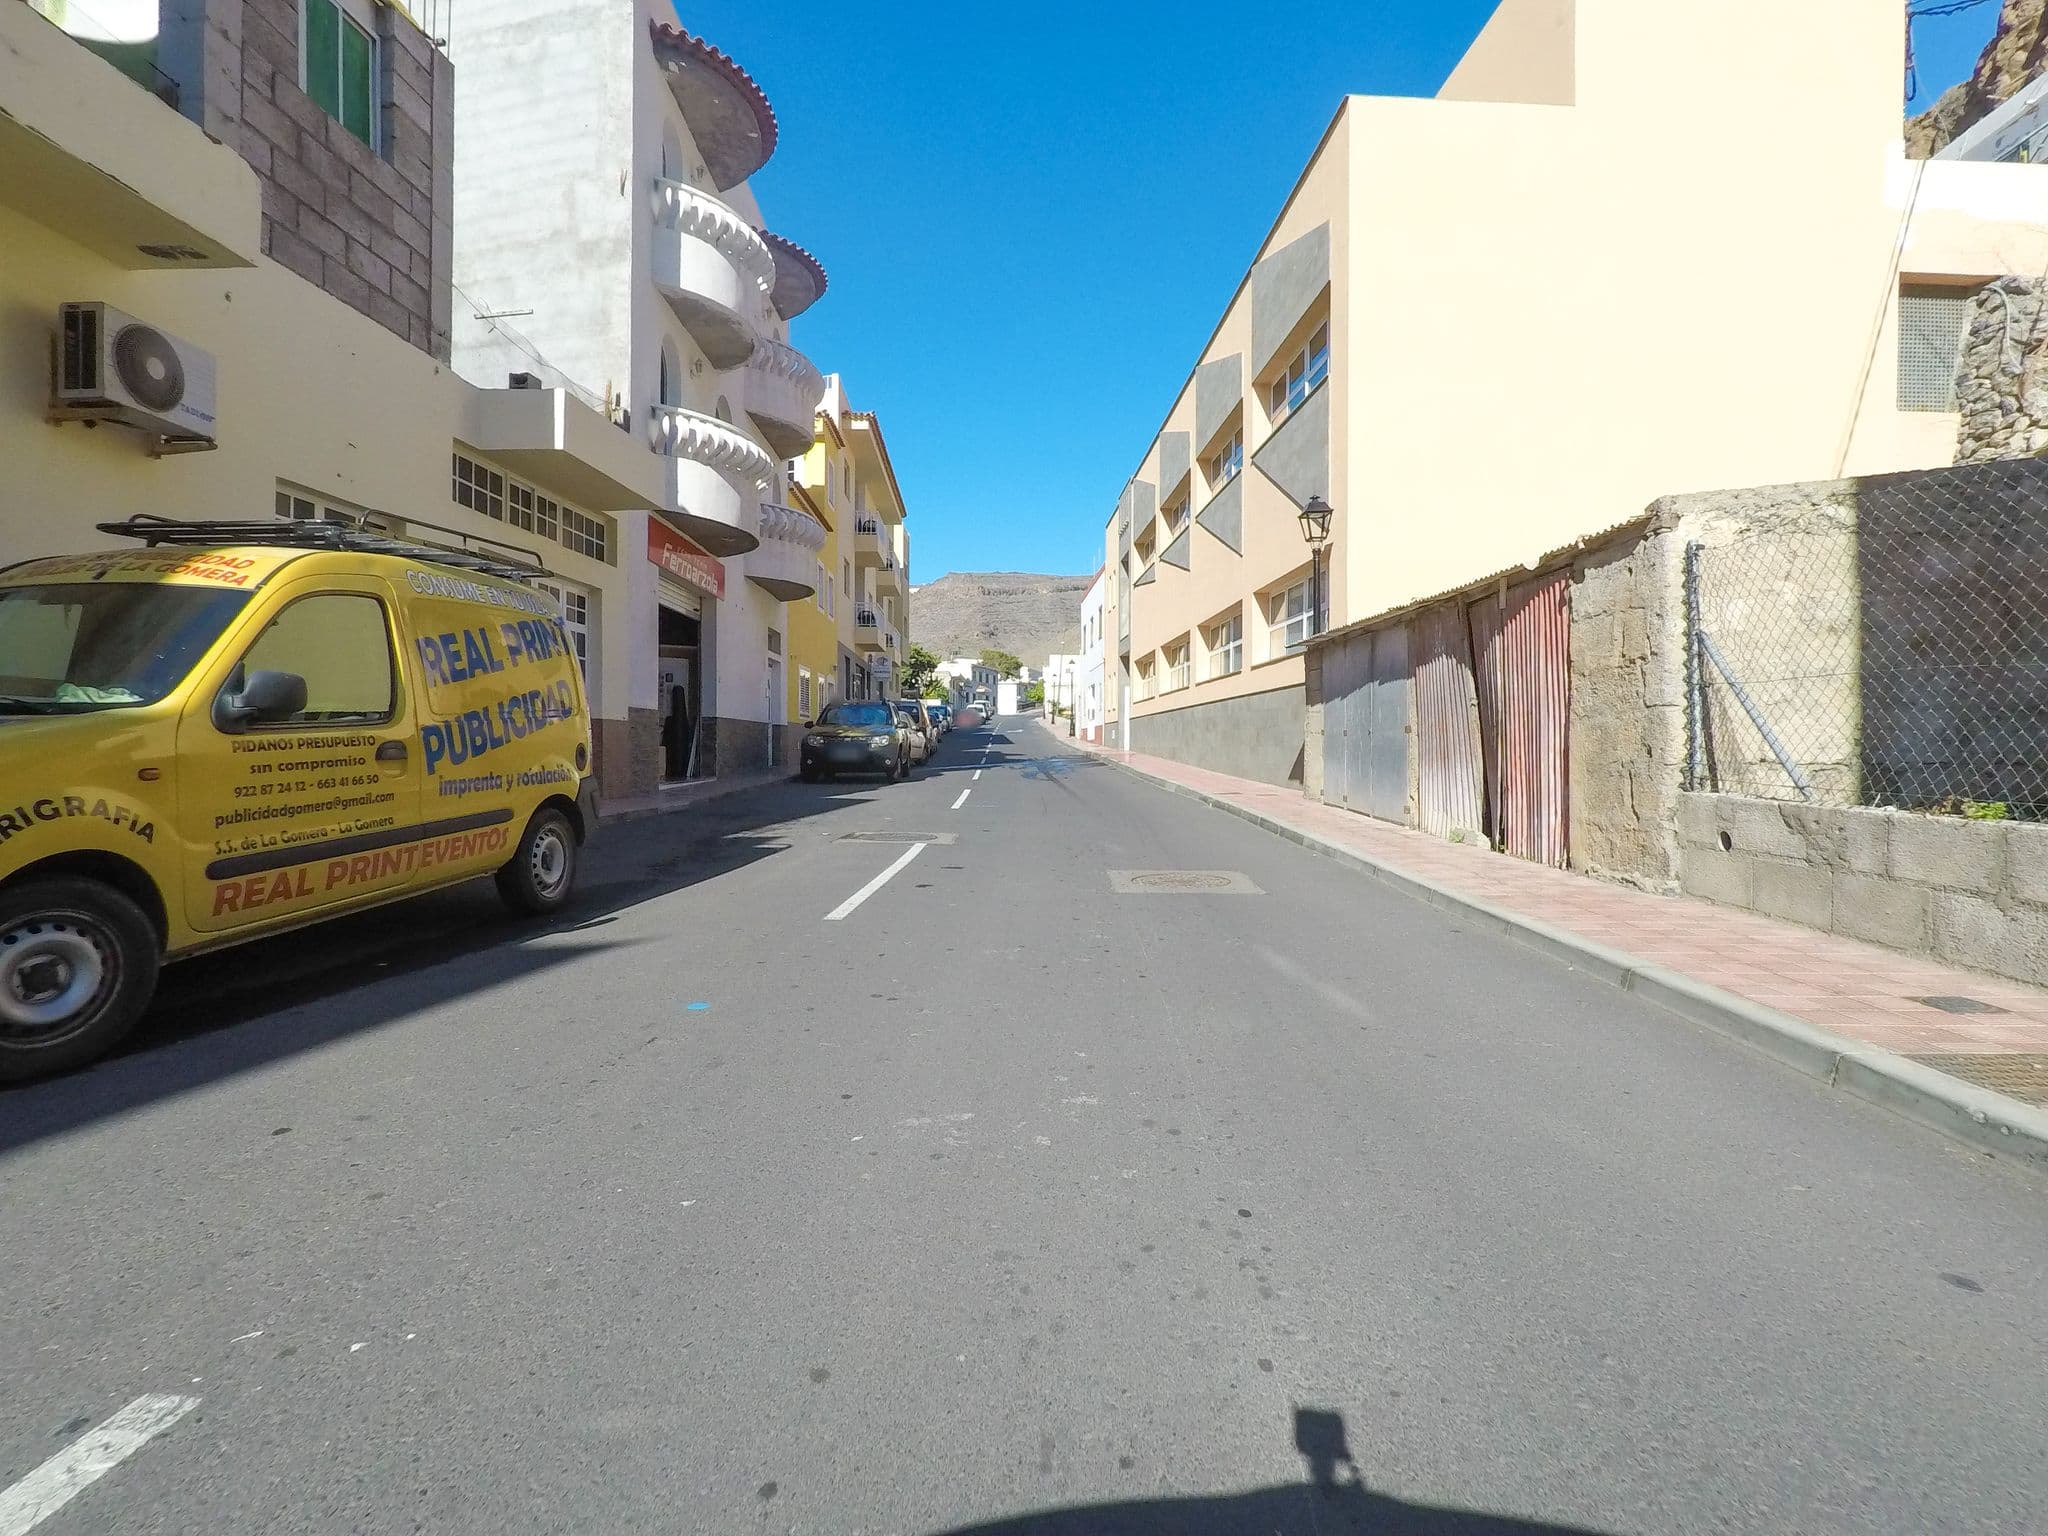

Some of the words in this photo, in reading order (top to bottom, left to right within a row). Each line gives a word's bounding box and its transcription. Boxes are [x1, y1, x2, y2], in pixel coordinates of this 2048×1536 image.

[154, 563, 250, 586] GOMERA
[406, 570, 486, 604] CONSUME
[415, 626, 505, 689] REAL
[500, 615, 571, 668] PRINT
[298, 735, 376, 749] PRESUPUESTO
[421, 679, 573, 776] PUBLICIDAD
[250, 762, 273, 774] sin
[277, 755, 367, 773] compromiso
[234, 785, 257, 799] 922
[260, 783, 274, 796] 87
[278, 781, 292, 794] 24
[317, 777, 337, 789] 663
[339, 776, 349, 788] 41
[352, 775, 365, 787] 66
[367, 774, 379, 785] 50
[439, 770, 503, 798] imprenta
[506, 775, 514, 792] y
[0, 796, 154, 845] RIGRAFIA
[215, 791, 395, 829] publicidadgomera@gmail.com
[240, 837, 258, 851] de
[261, 834, 278, 848] La
[280, 827, 328, 844] Gomera
[338, 821, 352, 834] La
[354, 816, 395, 832] Gomera
[212, 867, 316, 918] REAL
